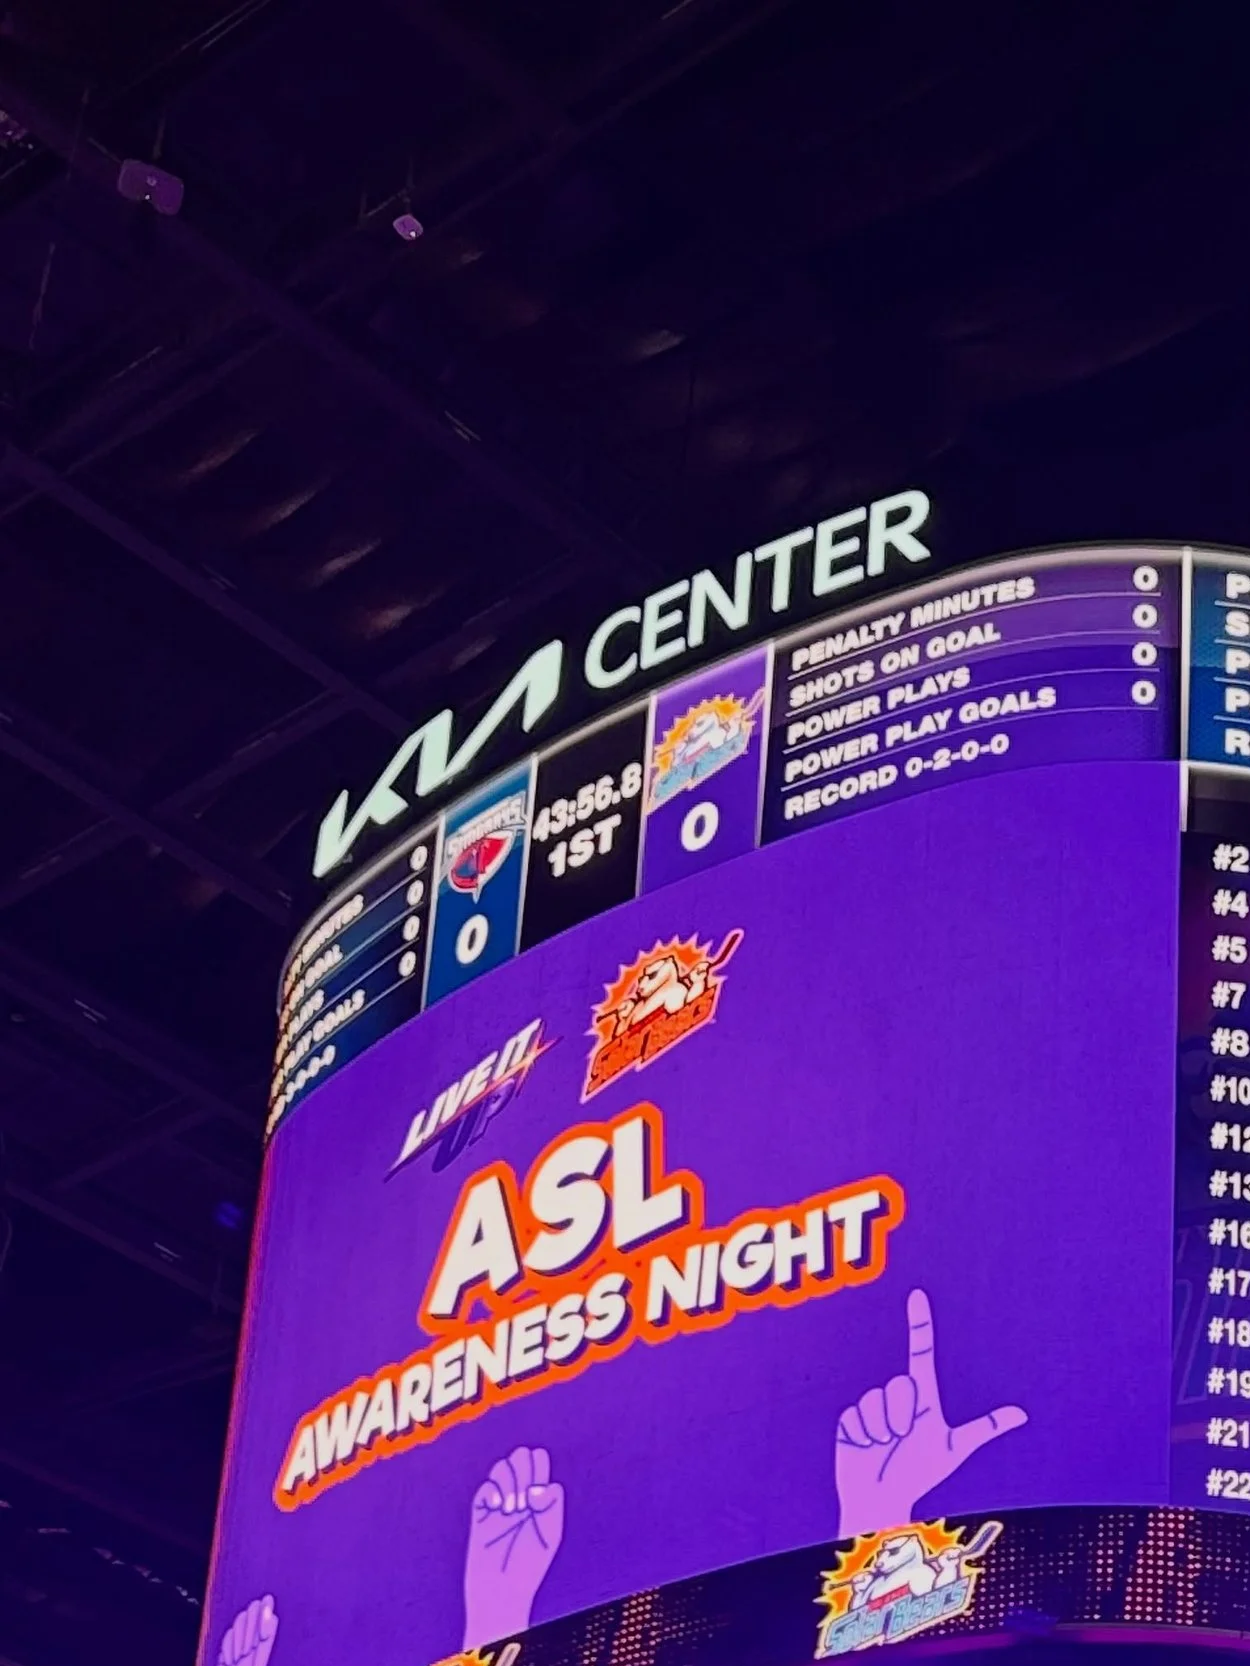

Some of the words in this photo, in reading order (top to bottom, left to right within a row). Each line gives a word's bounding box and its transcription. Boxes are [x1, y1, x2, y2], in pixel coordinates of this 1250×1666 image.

[584, 489, 931, 689] CENTER
[1133, 565, 1159, 592] 0
[791, 614, 904, 672] PENALTY
[910, 577, 1035, 630] MINUTES
[1132, 603, 1158, 629] 0
[789, 659, 875, 708] SHOTS
[881, 645, 919, 676] ON
[926, 623, 1001, 659] GOAL
[1131, 642, 1158, 666] 0
[787, 696, 881, 746] POWER
[888, 666, 970, 712] PLAYS
[1131, 679, 1156, 705] 0
[784, 732, 879, 783] POWER
[886, 708, 951, 747] PLAY
[959, 687, 1056, 723] GOALS
[784, 765, 898, 820] RECORD
[904, 733, 1010, 779] 0-2-0-0
[532, 763, 642, 843] 43:56.8
[680, 801, 719, 852] 0
[547, 814, 622, 878] 1ST
[1213, 844, 1250, 873] #2
[1212, 890, 1249, 919] #4
[454, 913, 489, 965] 0
[1212, 935, 1247, 963] #5
[1211, 981, 1245, 1009] #7
[1211, 1028, 1249, 1057] #8
[396, 1050, 499, 1163] LIVE
[493, 1017, 542, 1081] IT
[426, 1115, 685, 1322] ASL
[284, 1272, 629, 1493] AWARENESS
[645, 1190, 882, 1323] NIGHT
[1207, 1418, 1250, 1448] #21
